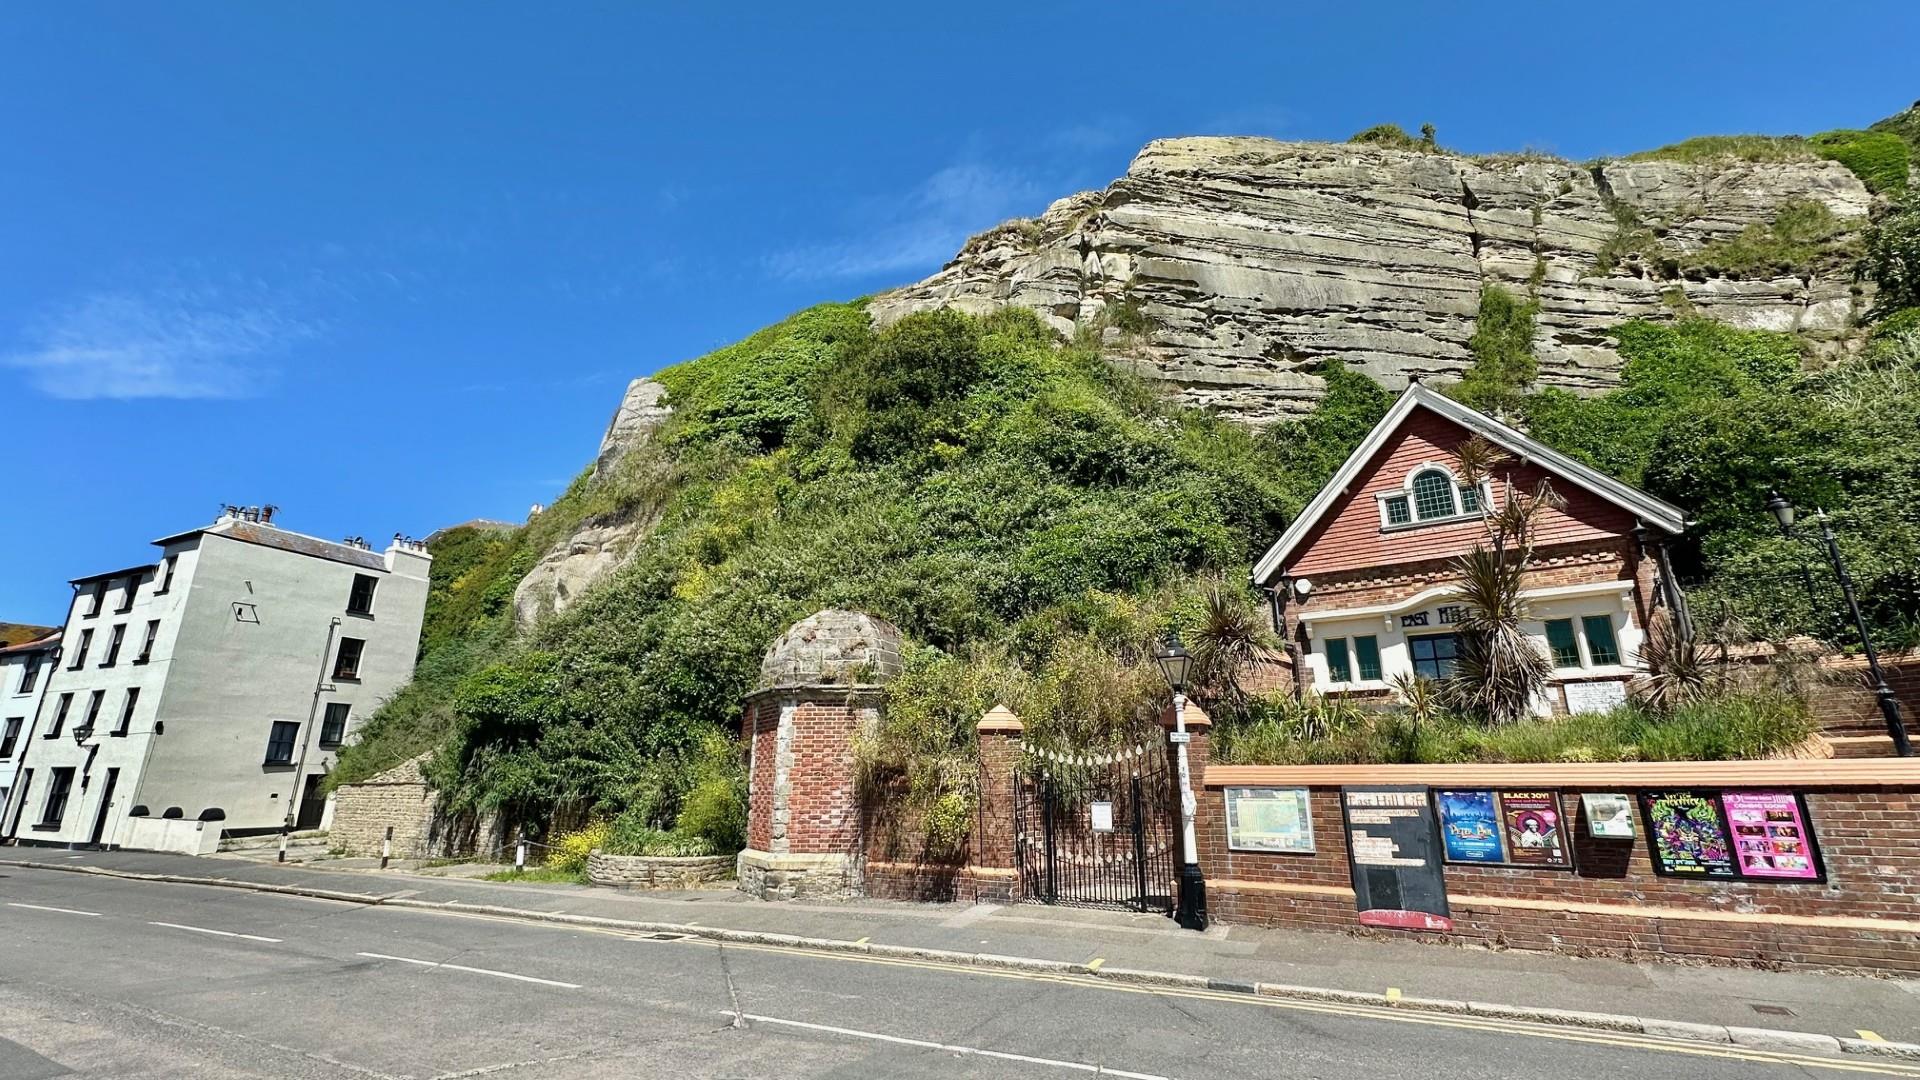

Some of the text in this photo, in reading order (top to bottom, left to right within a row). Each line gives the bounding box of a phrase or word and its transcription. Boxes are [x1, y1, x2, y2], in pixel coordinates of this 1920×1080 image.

[1400, 611, 1429, 627] EAST
[1348, 794, 1425, 806] East Hill Lift
